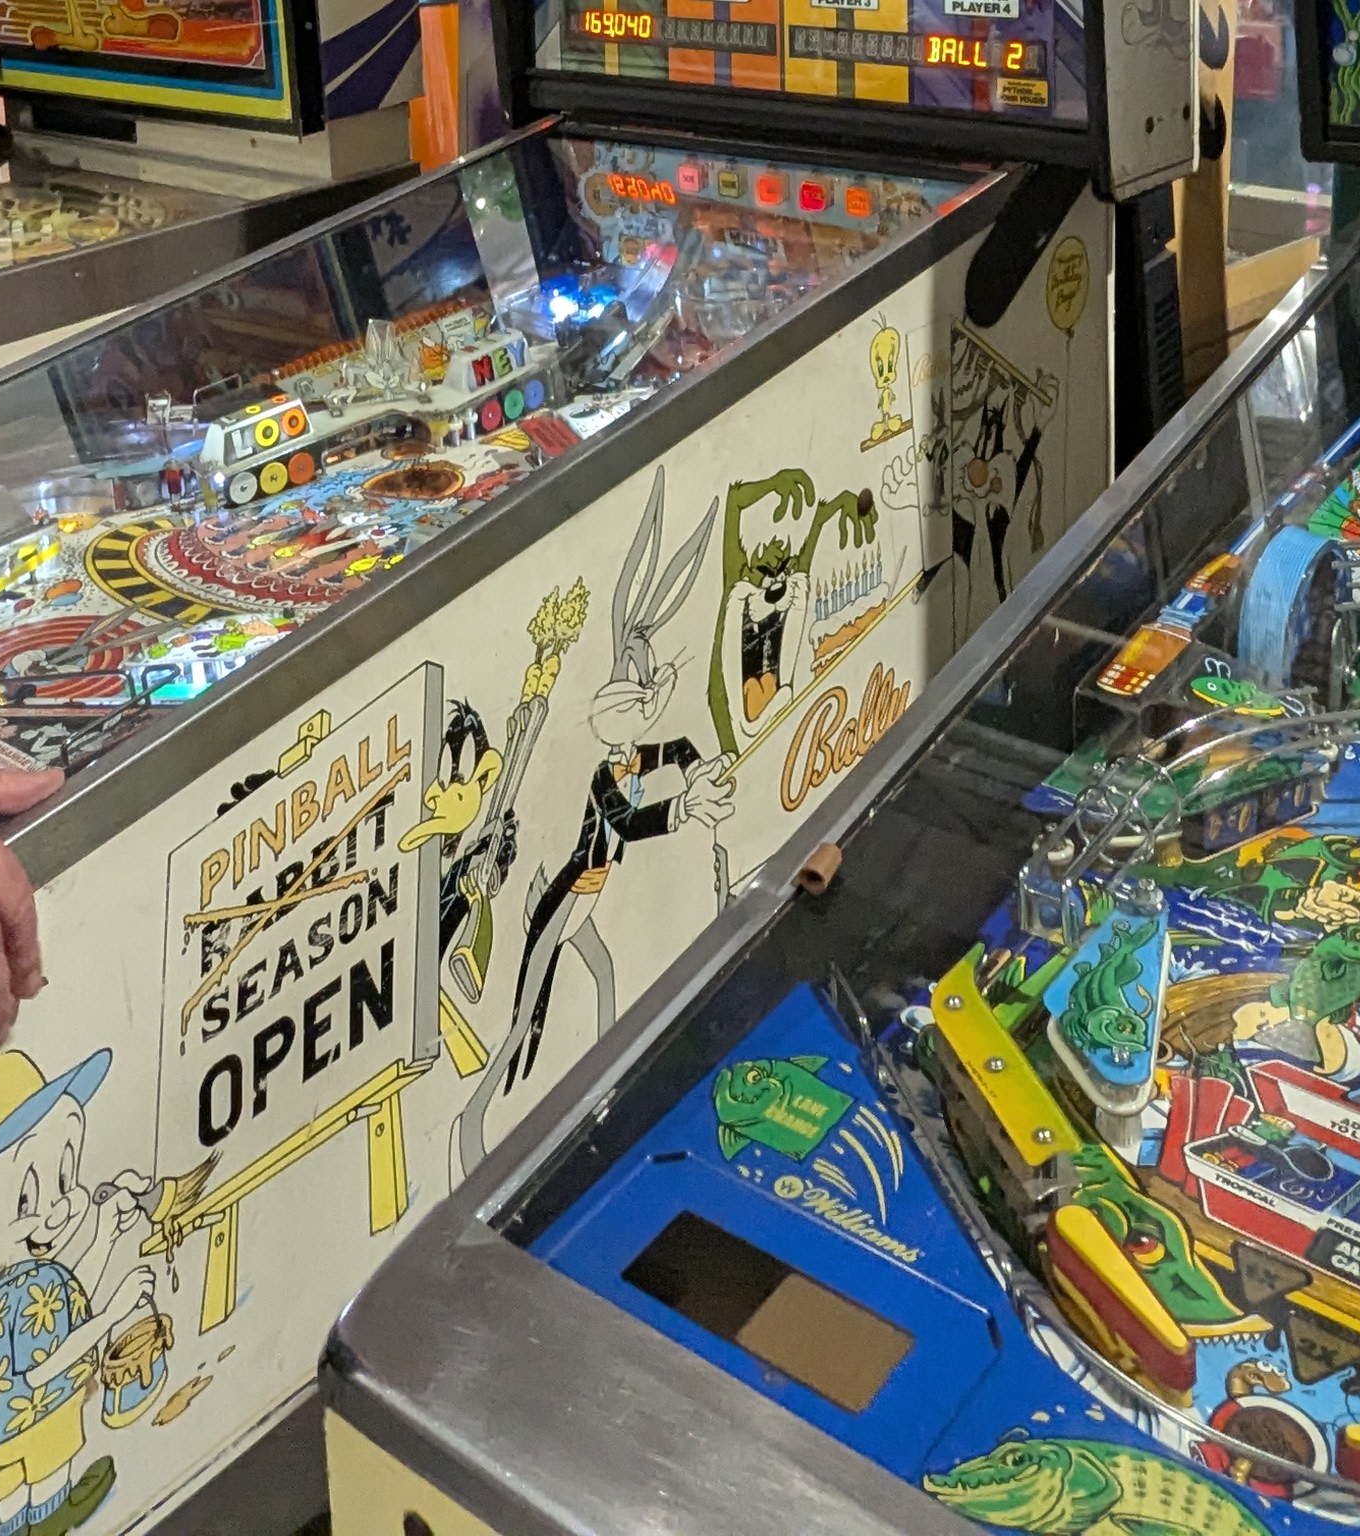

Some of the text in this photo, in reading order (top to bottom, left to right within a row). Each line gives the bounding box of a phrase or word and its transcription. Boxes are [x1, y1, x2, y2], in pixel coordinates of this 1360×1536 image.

[951, 1, 1011, 14] PLAYER 4
[926, 35, 1024, 71] BALL 2
[200, 714, 412, 912] PINBALL
[200, 790, 395, 979] RABBIT
[201, 861, 400, 1043] SEASON
[198, 937, 396, 1149] OPEN
[1329, 1120, 1350, 1134] TO
[802, 1180, 920, 1263] Williams
[1214, 1173, 1277, 1208] TROPICAL
